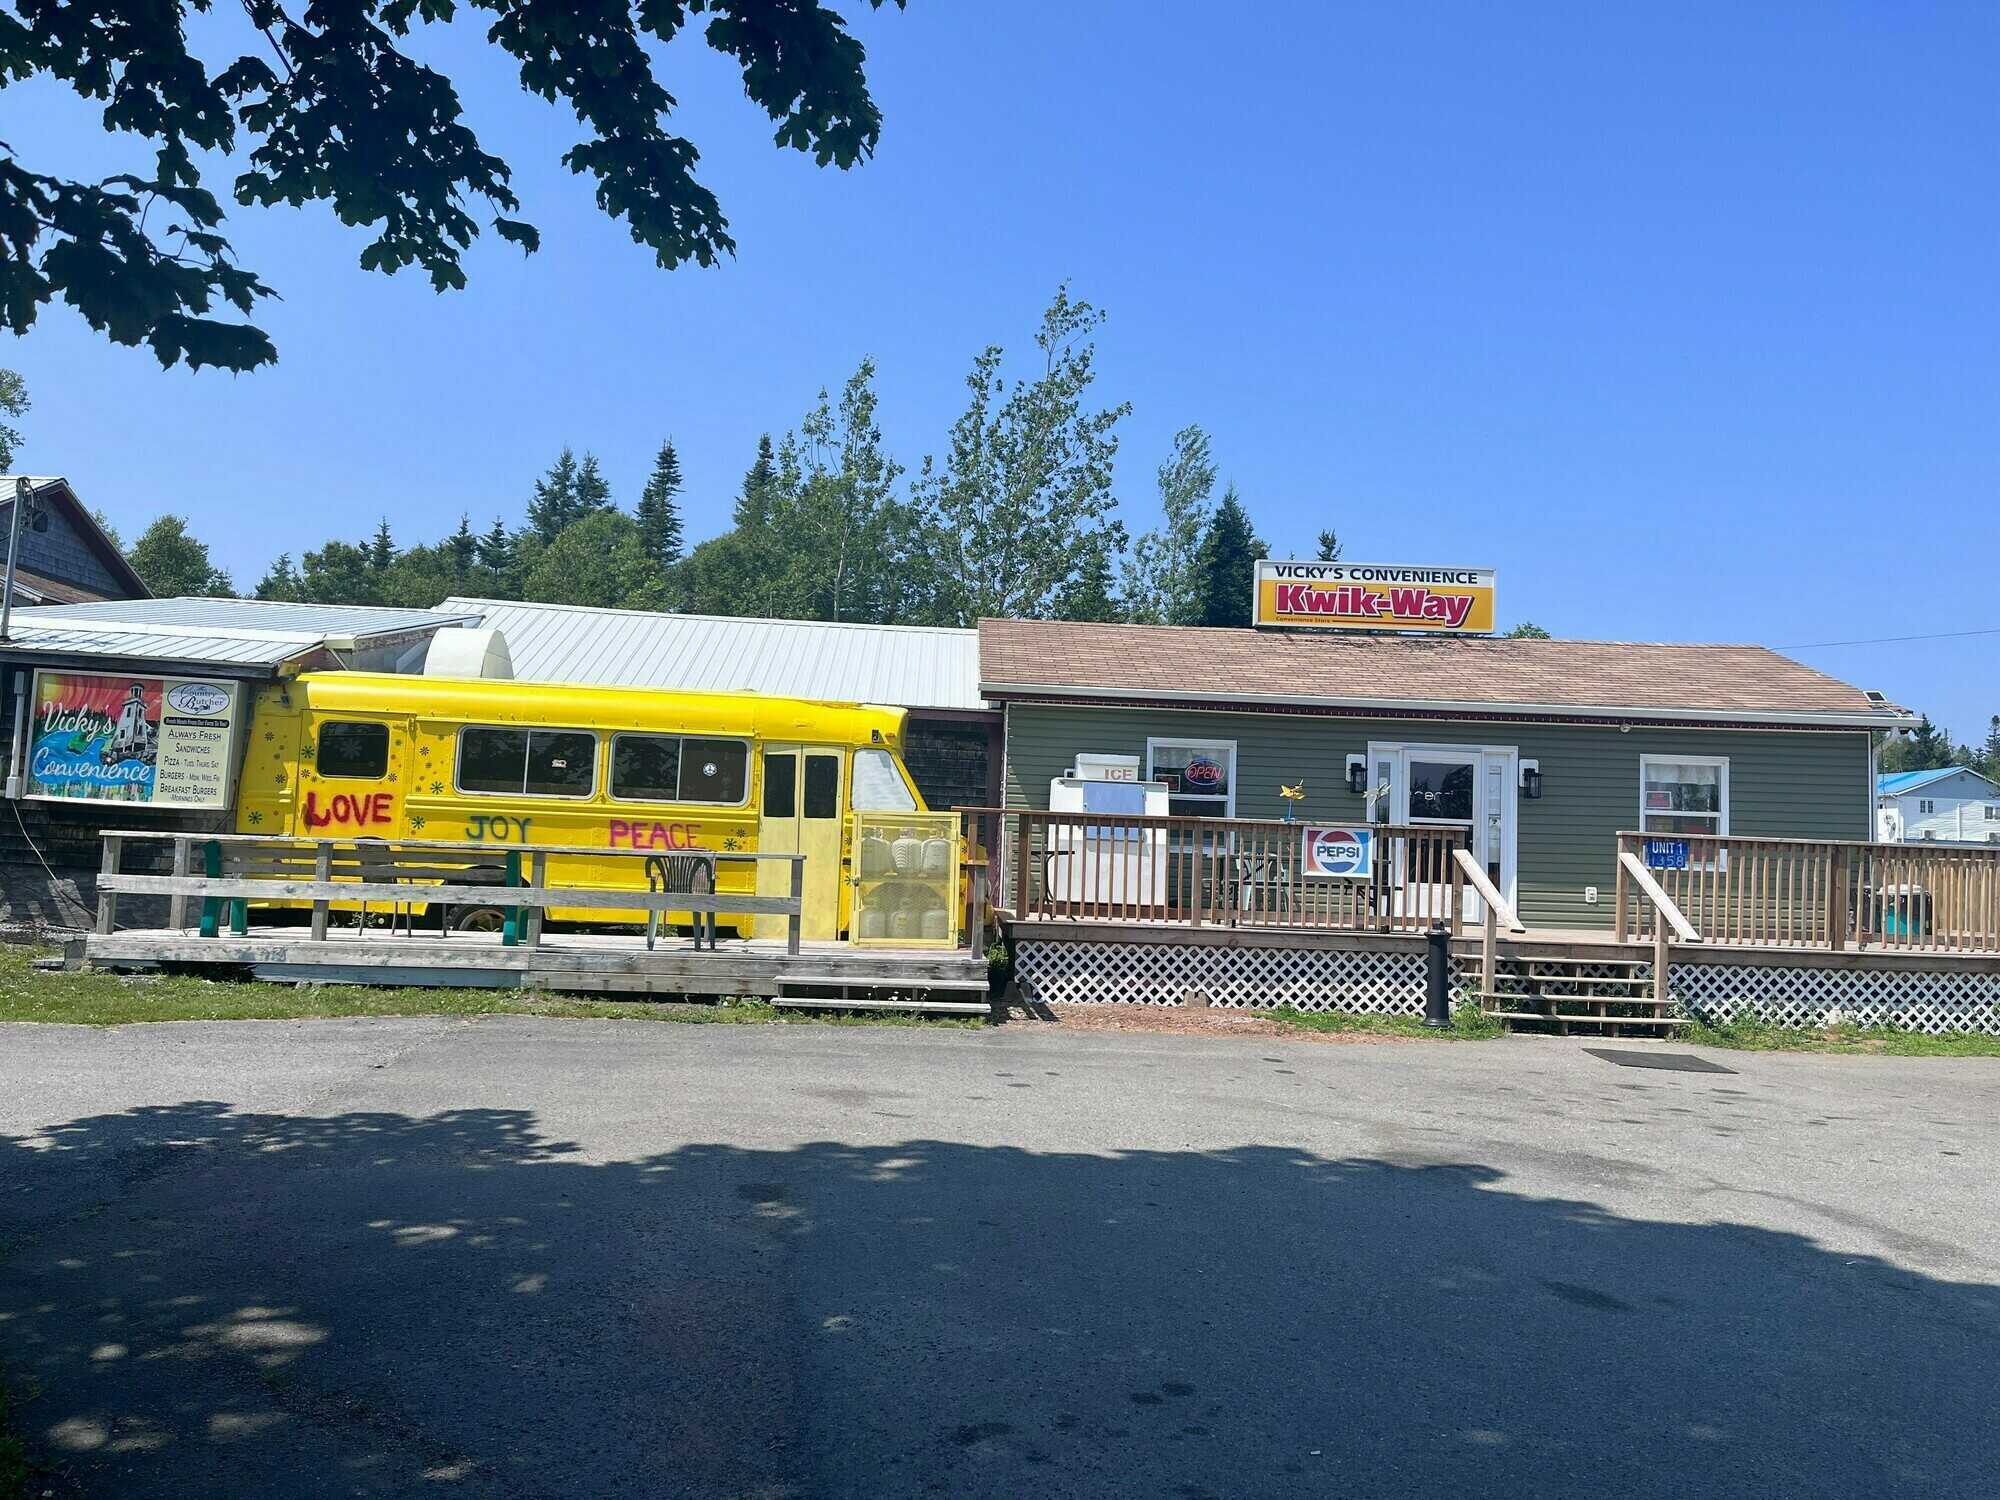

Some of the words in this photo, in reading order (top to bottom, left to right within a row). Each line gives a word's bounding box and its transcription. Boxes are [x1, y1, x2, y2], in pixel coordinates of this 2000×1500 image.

[1275, 565, 1344, 580] VICKY'S
[1349, 568, 1478, 584] CONVENIENCE
[1276, 583, 1474, 628] Kwik-Way
[181, 685, 217, 698] Country
[178, 695, 224, 710] Butcher
[43, 701, 115, 741] Vicky's
[168, 729, 197, 739] ALWAYS
[199, 731, 221, 741] FRESH
[175, 743, 211, 754] SANDWICHES
[32, 747, 151, 781] Convenience
[164, 756, 179, 767] PIZZA
[160, 769, 185, 780] BURGERS
[1104, 768, 1133, 780] ICE
[1187, 766, 1221, 779] OPEN
[160, 783, 191, 795] BREAKFAST
[192, 785, 217, 796] BURGERS
[305, 791, 394, 827] LOVE
[465, 815, 532, 843] JOY
[609, 818, 706, 850] PEACE
[1316, 845, 1360, 858] PEPSI
[1652, 841, 1675, 854] UNIT
[1677, 843, 1683, 854] 1
[1651, 855, 1684, 867] 1358
